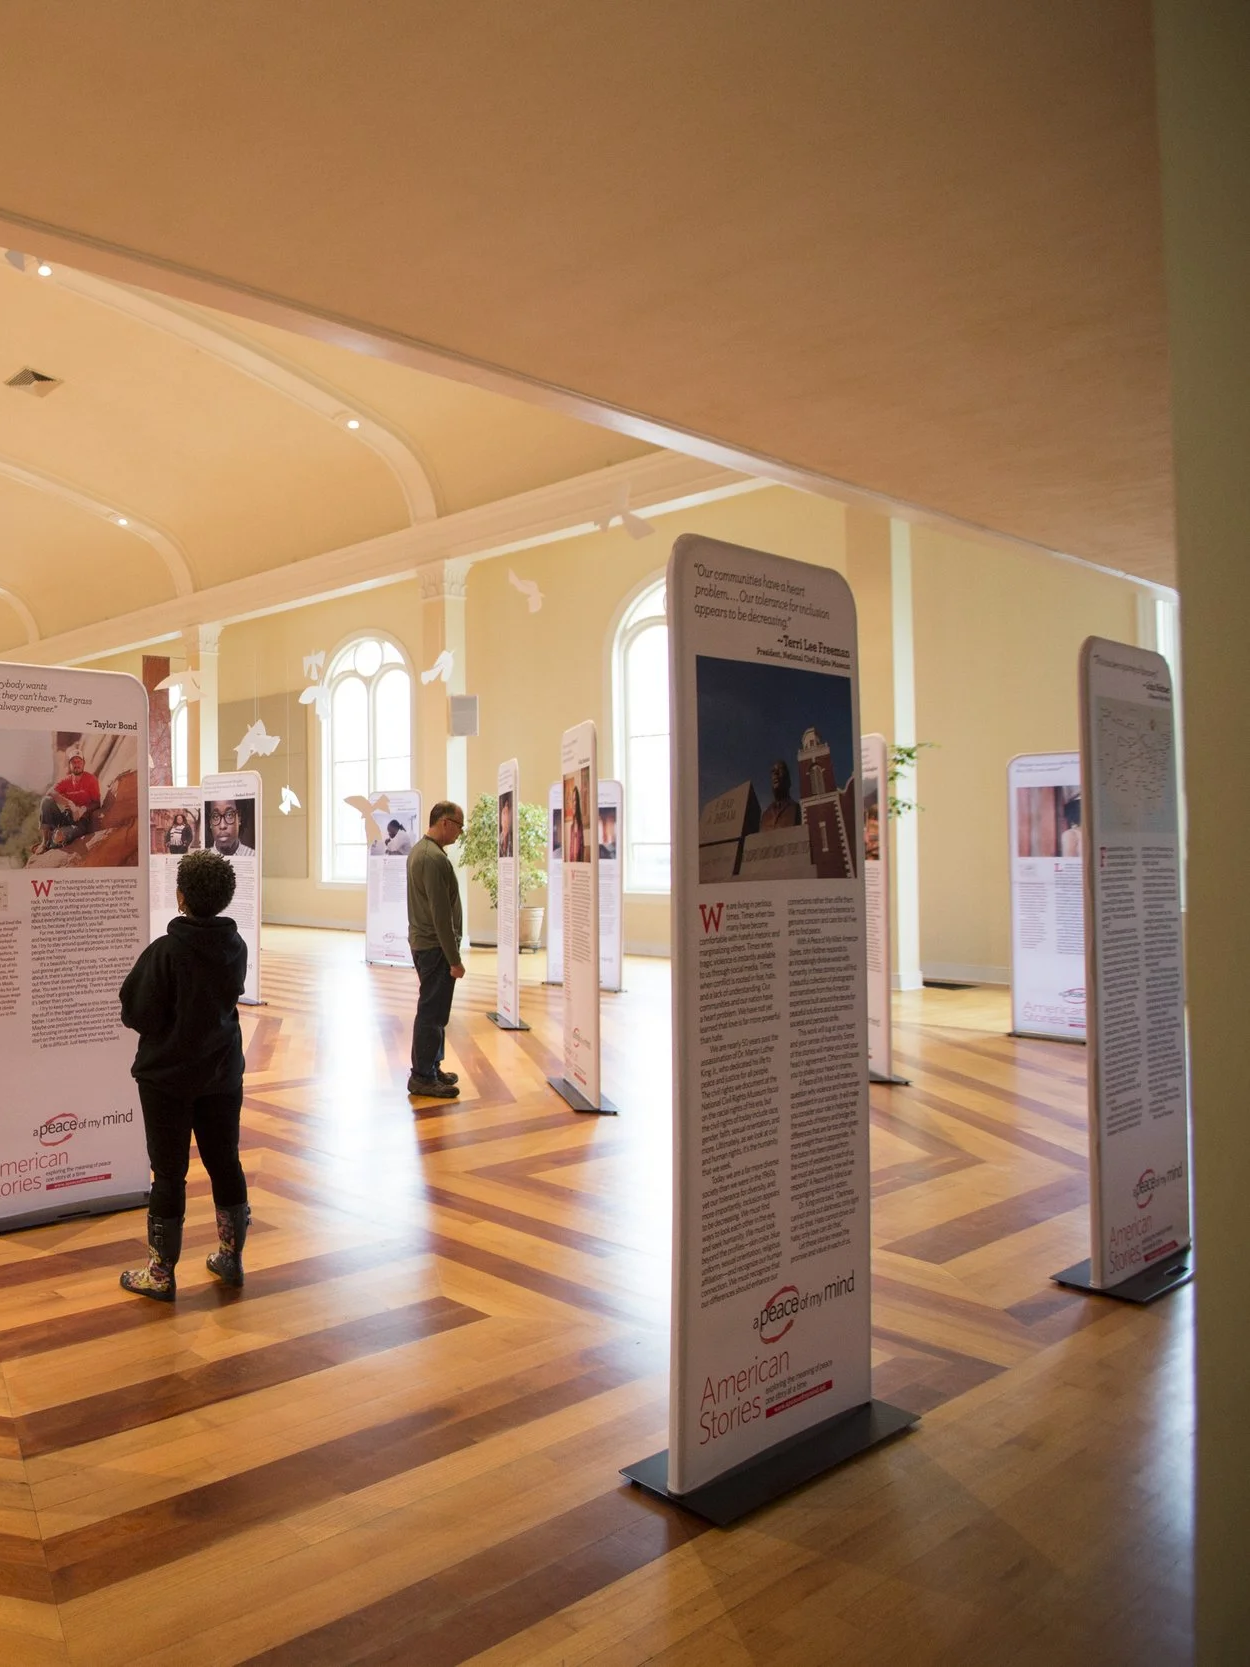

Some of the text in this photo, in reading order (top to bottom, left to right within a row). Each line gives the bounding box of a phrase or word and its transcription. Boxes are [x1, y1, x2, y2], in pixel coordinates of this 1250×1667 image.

[714, 570, 762, 587] communities
[763, 574, 780, 589] have
[787, 580, 804, 597] heart
[694, 603, 727, 618] appears
[729, 609, 736, 620] to
[738, 609, 747, 621] be
[740, 591, 754, 603] Our
[755, 594, 788, 610] tolerance
[789, 599, 799, 612] for
[800, 602, 830, 619] inclusion
[783, 650, 803, 662] National
[804, 654, 815, 663] Civil
[804, 639, 817, 652] Lee
[818, 641, 849, 658] Freeman
[2, 692, 18, 701] they
[19, 693, 37, 701] can't
[38, 694, 57, 702] have.
[59, 694, 72, 703] The
[73, 698, 92, 706] grass
[118, 722, 137, 730] Bond
[33, 1109, 133, 1138] a peace of my mind
[46, 1168, 66, 1176] exploring
[75, 1163, 93, 1171] meaning
[1111, 1216, 1152, 1246] American
[1110, 1244, 1141, 1274] Stories
[753, 1270, 854, 1332] a peace of my mind
[700, 1351, 789, 1411] American
[766, 1380, 786, 1395] exploring
[795, 1367, 815, 1381] meaning
[820, 1360, 832, 1371] peace
[700, 1396, 761, 1445] Stories
